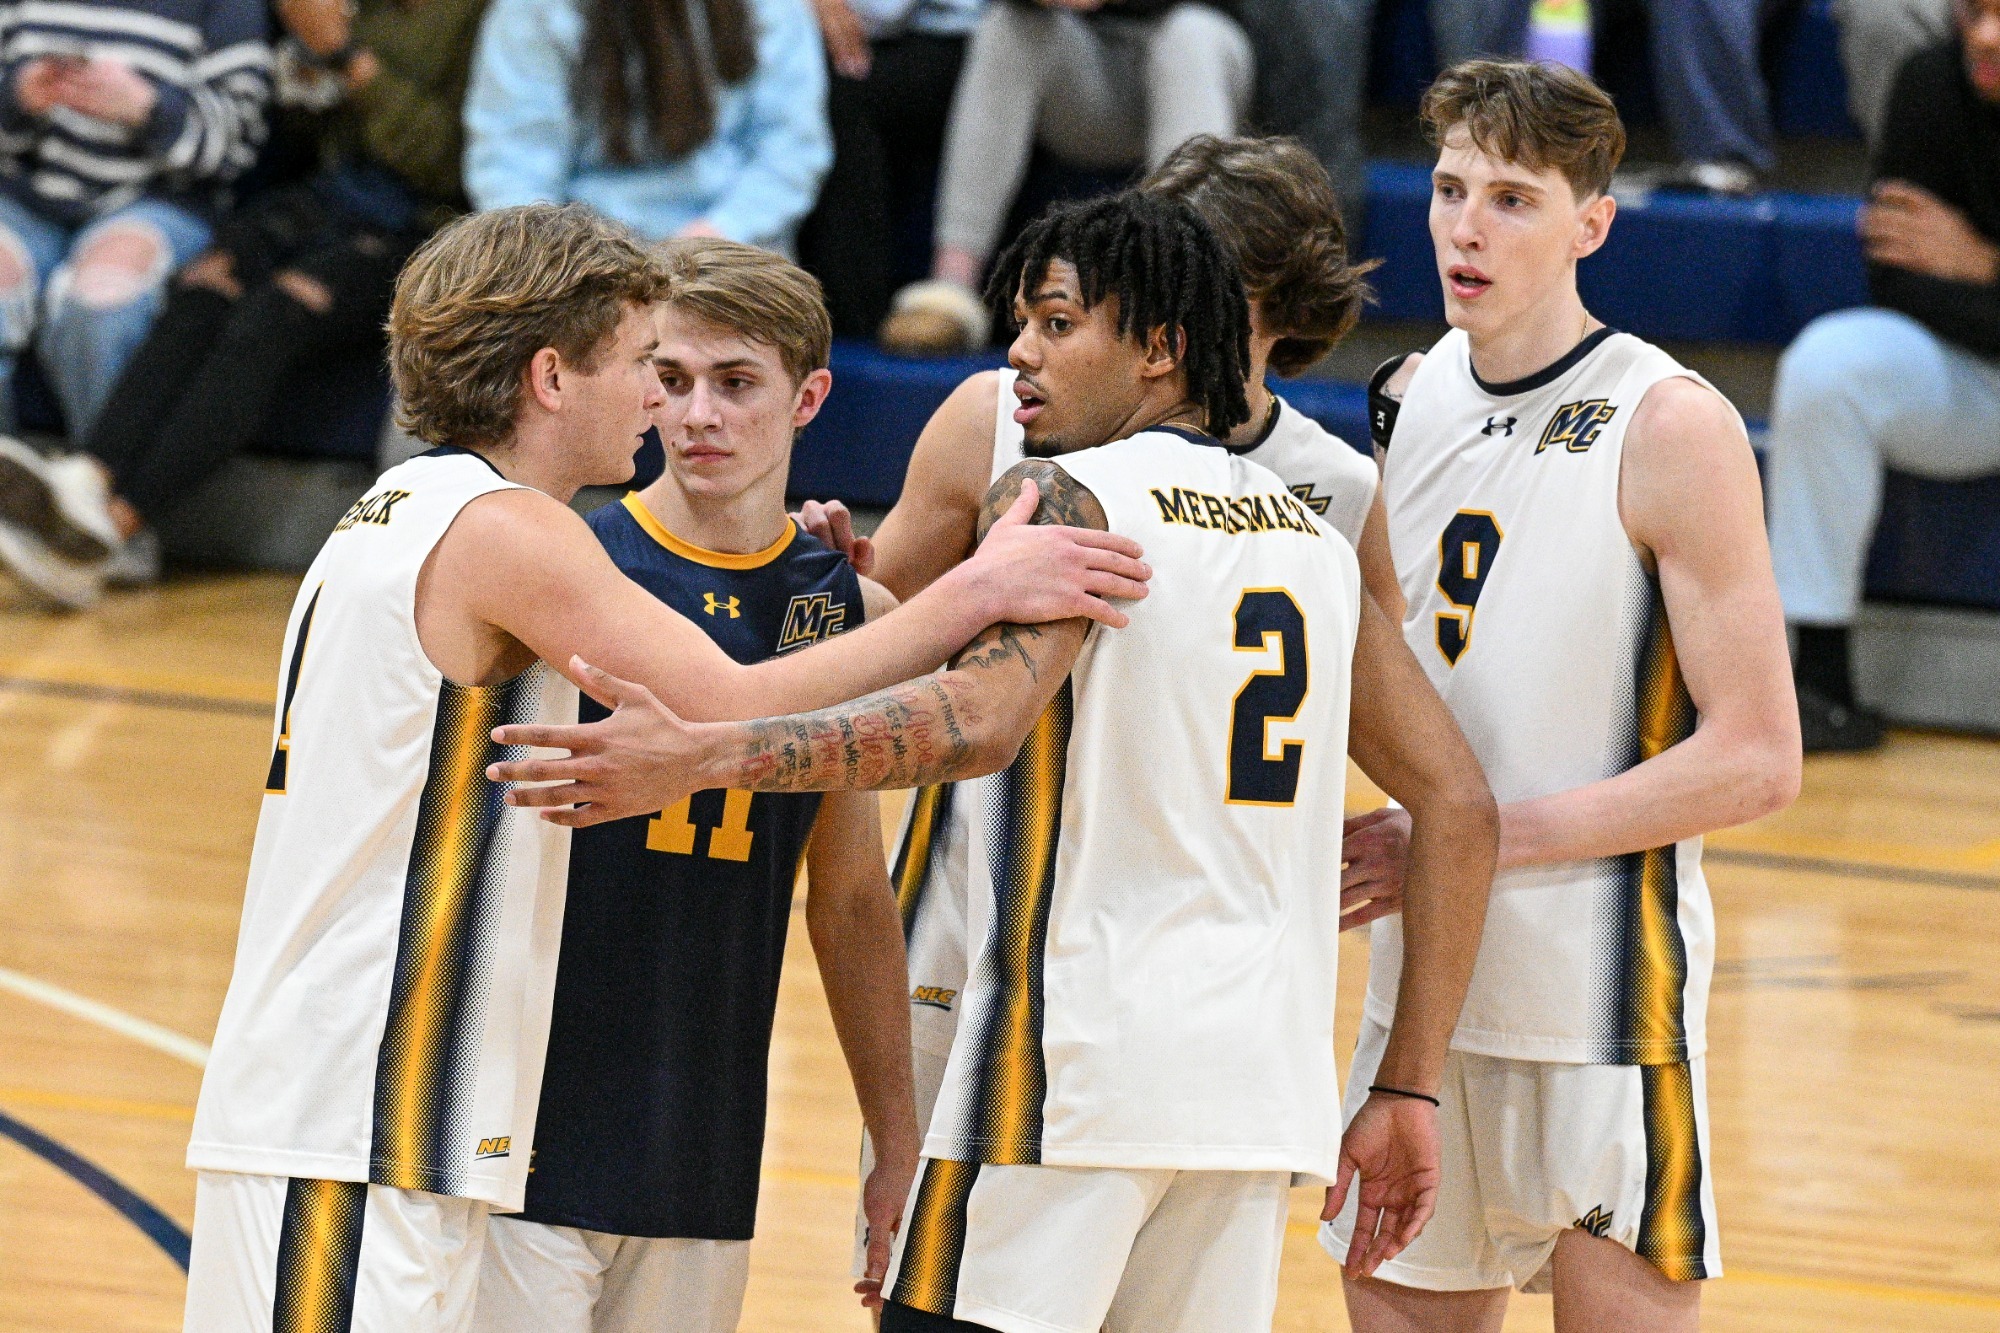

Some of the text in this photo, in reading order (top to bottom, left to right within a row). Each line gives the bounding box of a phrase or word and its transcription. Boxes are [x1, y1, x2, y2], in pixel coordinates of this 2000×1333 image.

[1435, 508, 1505, 670] 9
[1224, 587, 1310, 807] 2
[476, 1136, 511, 1155] NE
